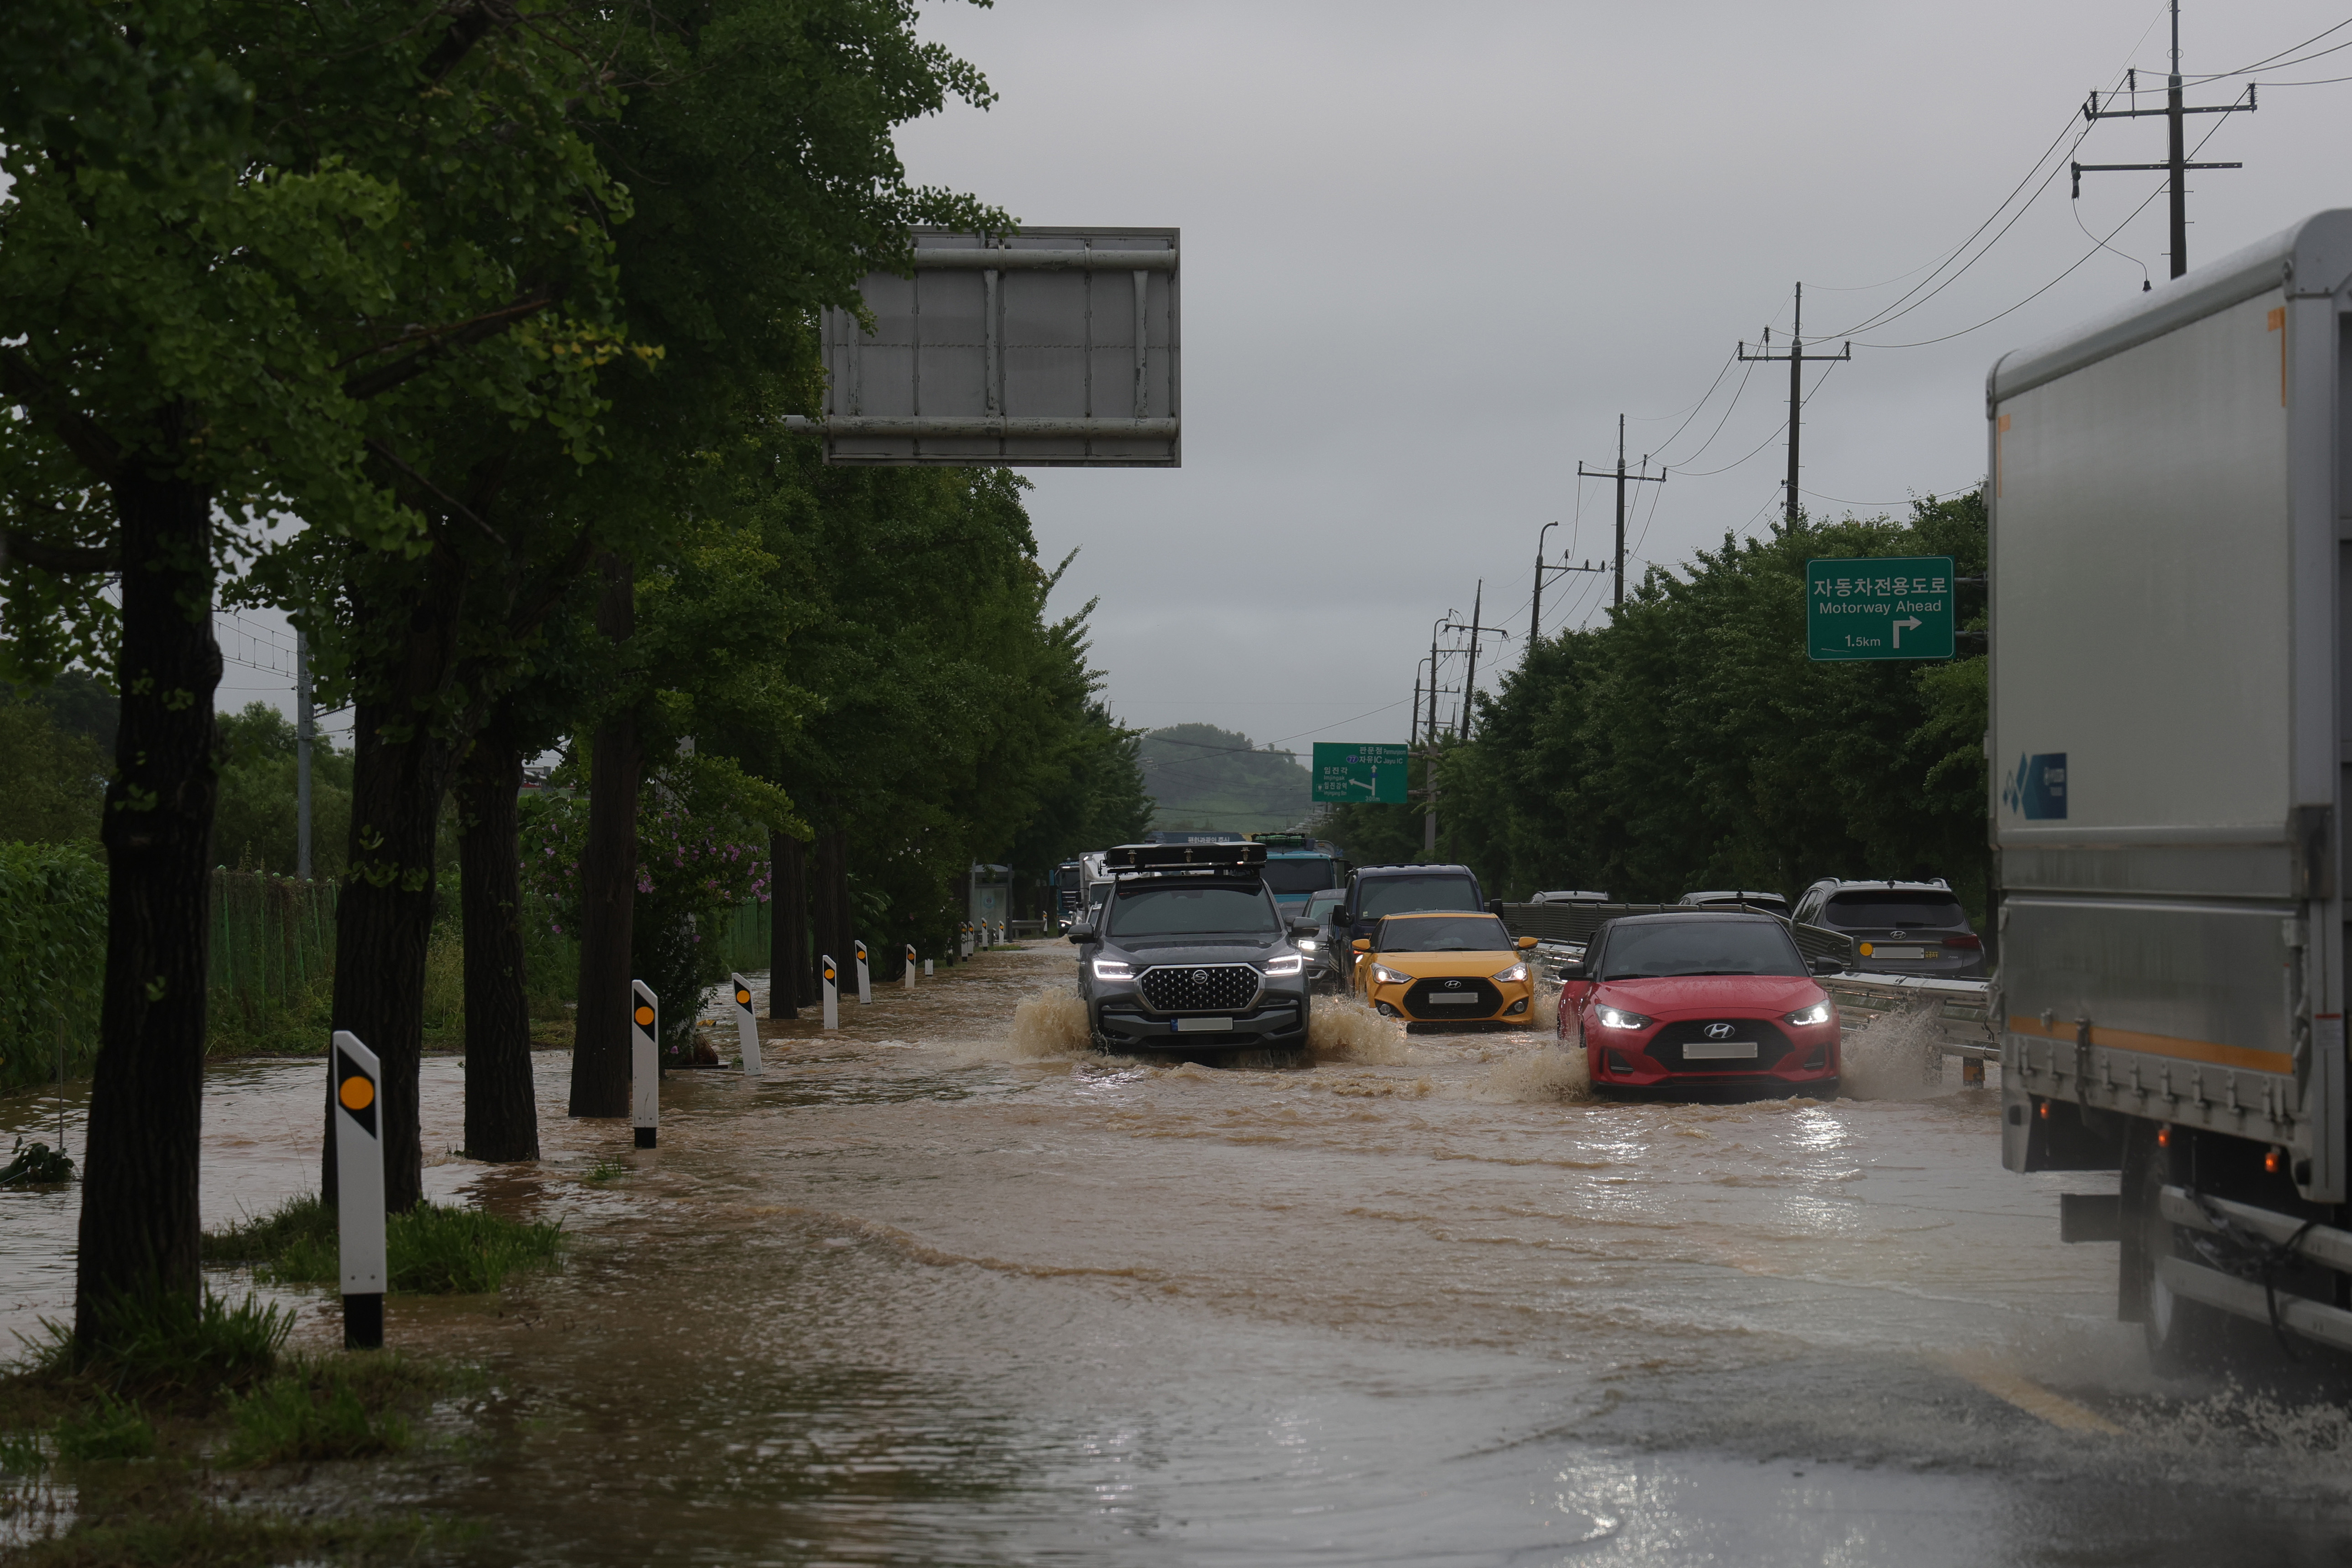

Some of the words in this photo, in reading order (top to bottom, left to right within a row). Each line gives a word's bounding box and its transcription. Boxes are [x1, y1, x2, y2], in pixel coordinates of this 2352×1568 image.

[1813, 577, 1947, 597] 자동차전용도로
[1819, 601, 1890, 615] Motorway
[1896, 600, 1942, 612] Ahead
[1845, 635, 1880, 647] 1.5km
[1359, 747, 1382, 755] 판문점
[1324, 782, 1347, 790] 임진강역
